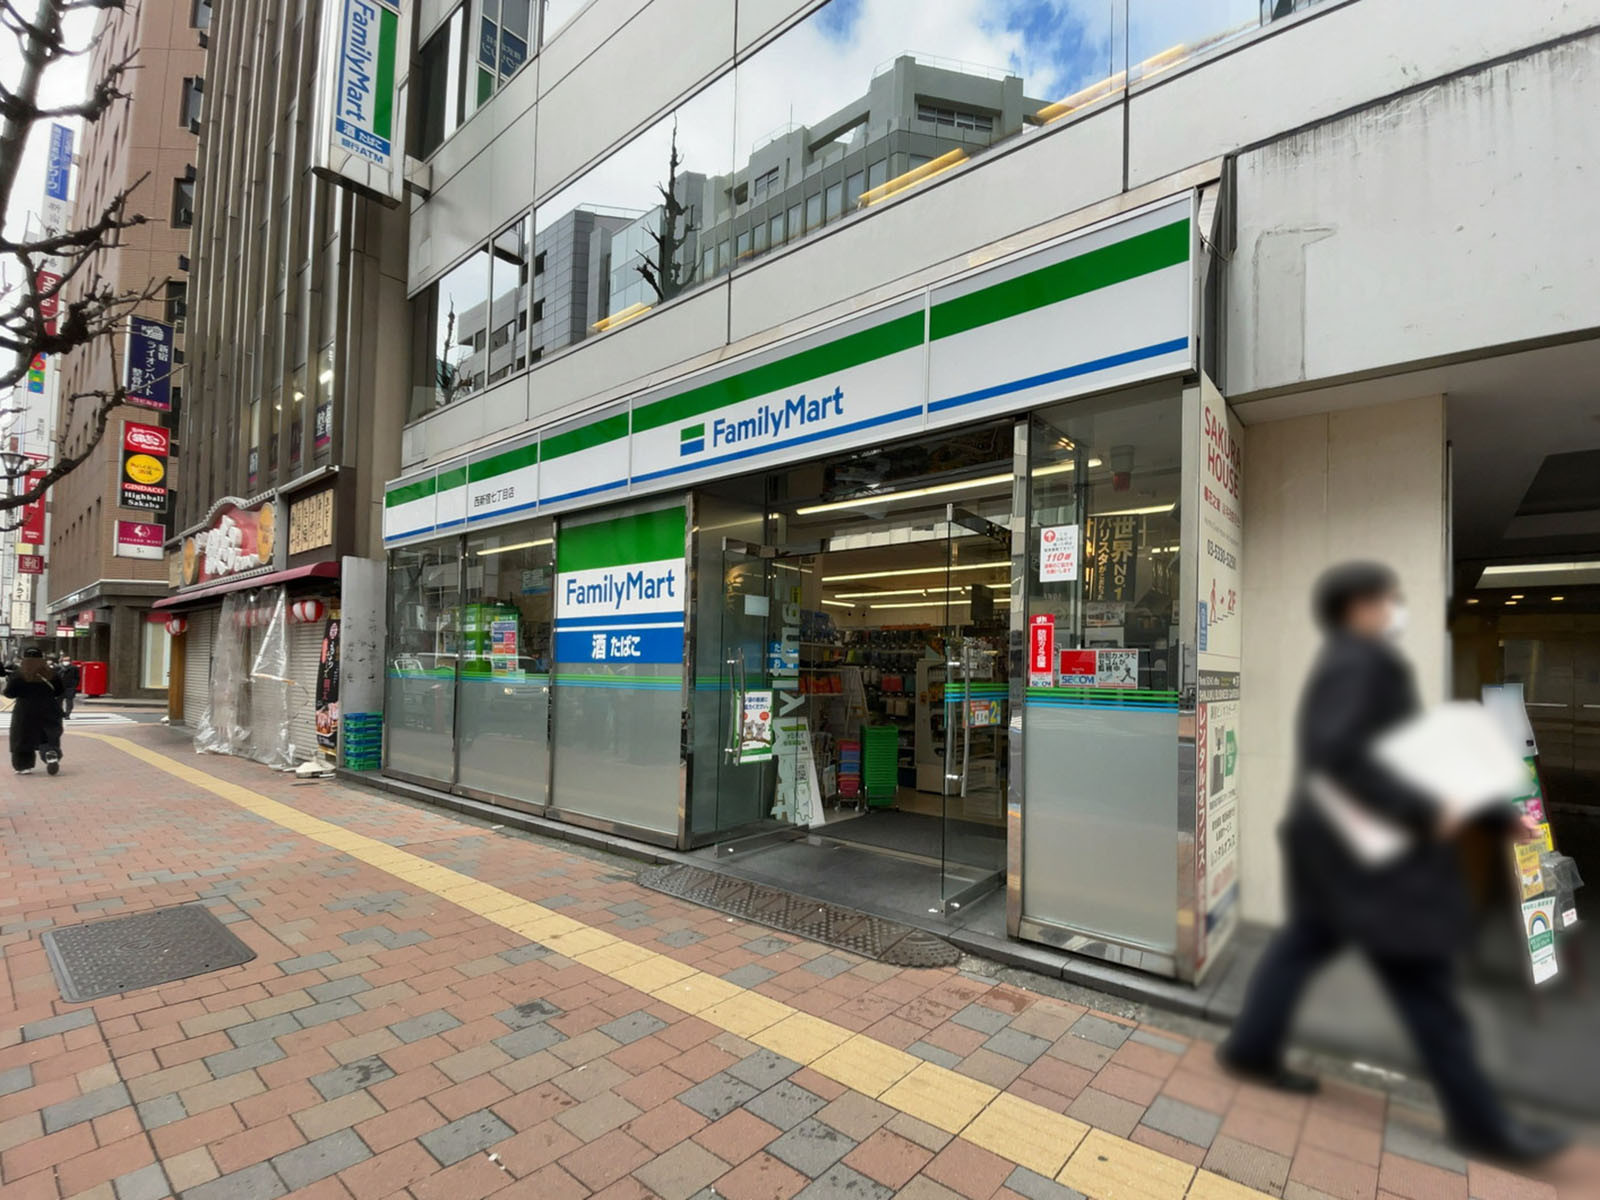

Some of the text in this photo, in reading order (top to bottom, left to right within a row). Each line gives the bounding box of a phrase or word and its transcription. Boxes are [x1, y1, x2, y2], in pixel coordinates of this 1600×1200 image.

[346, 0, 375, 122] FamilyMart
[343, 122, 383, 151] 酒 たばこ
[713, 386, 844, 448] FamilyMart
[1205, 406, 1241, 475] SAKURA
[1208, 443, 1238, 500] HOUSE
[124, 483, 165, 494] GINDACO
[124, 492, 164, 503] Highball
[474, 486, 515, 508] 西新宿七丁目店
[128, 500, 160, 509] Sakaba
[566, 568, 675, 610] FamilyMart
[592, 633, 641, 659] 酒 たばこ
[1061, 675, 1095, 684] SECOM
[1198, 704, 1206, 868] レンタルオフィス
